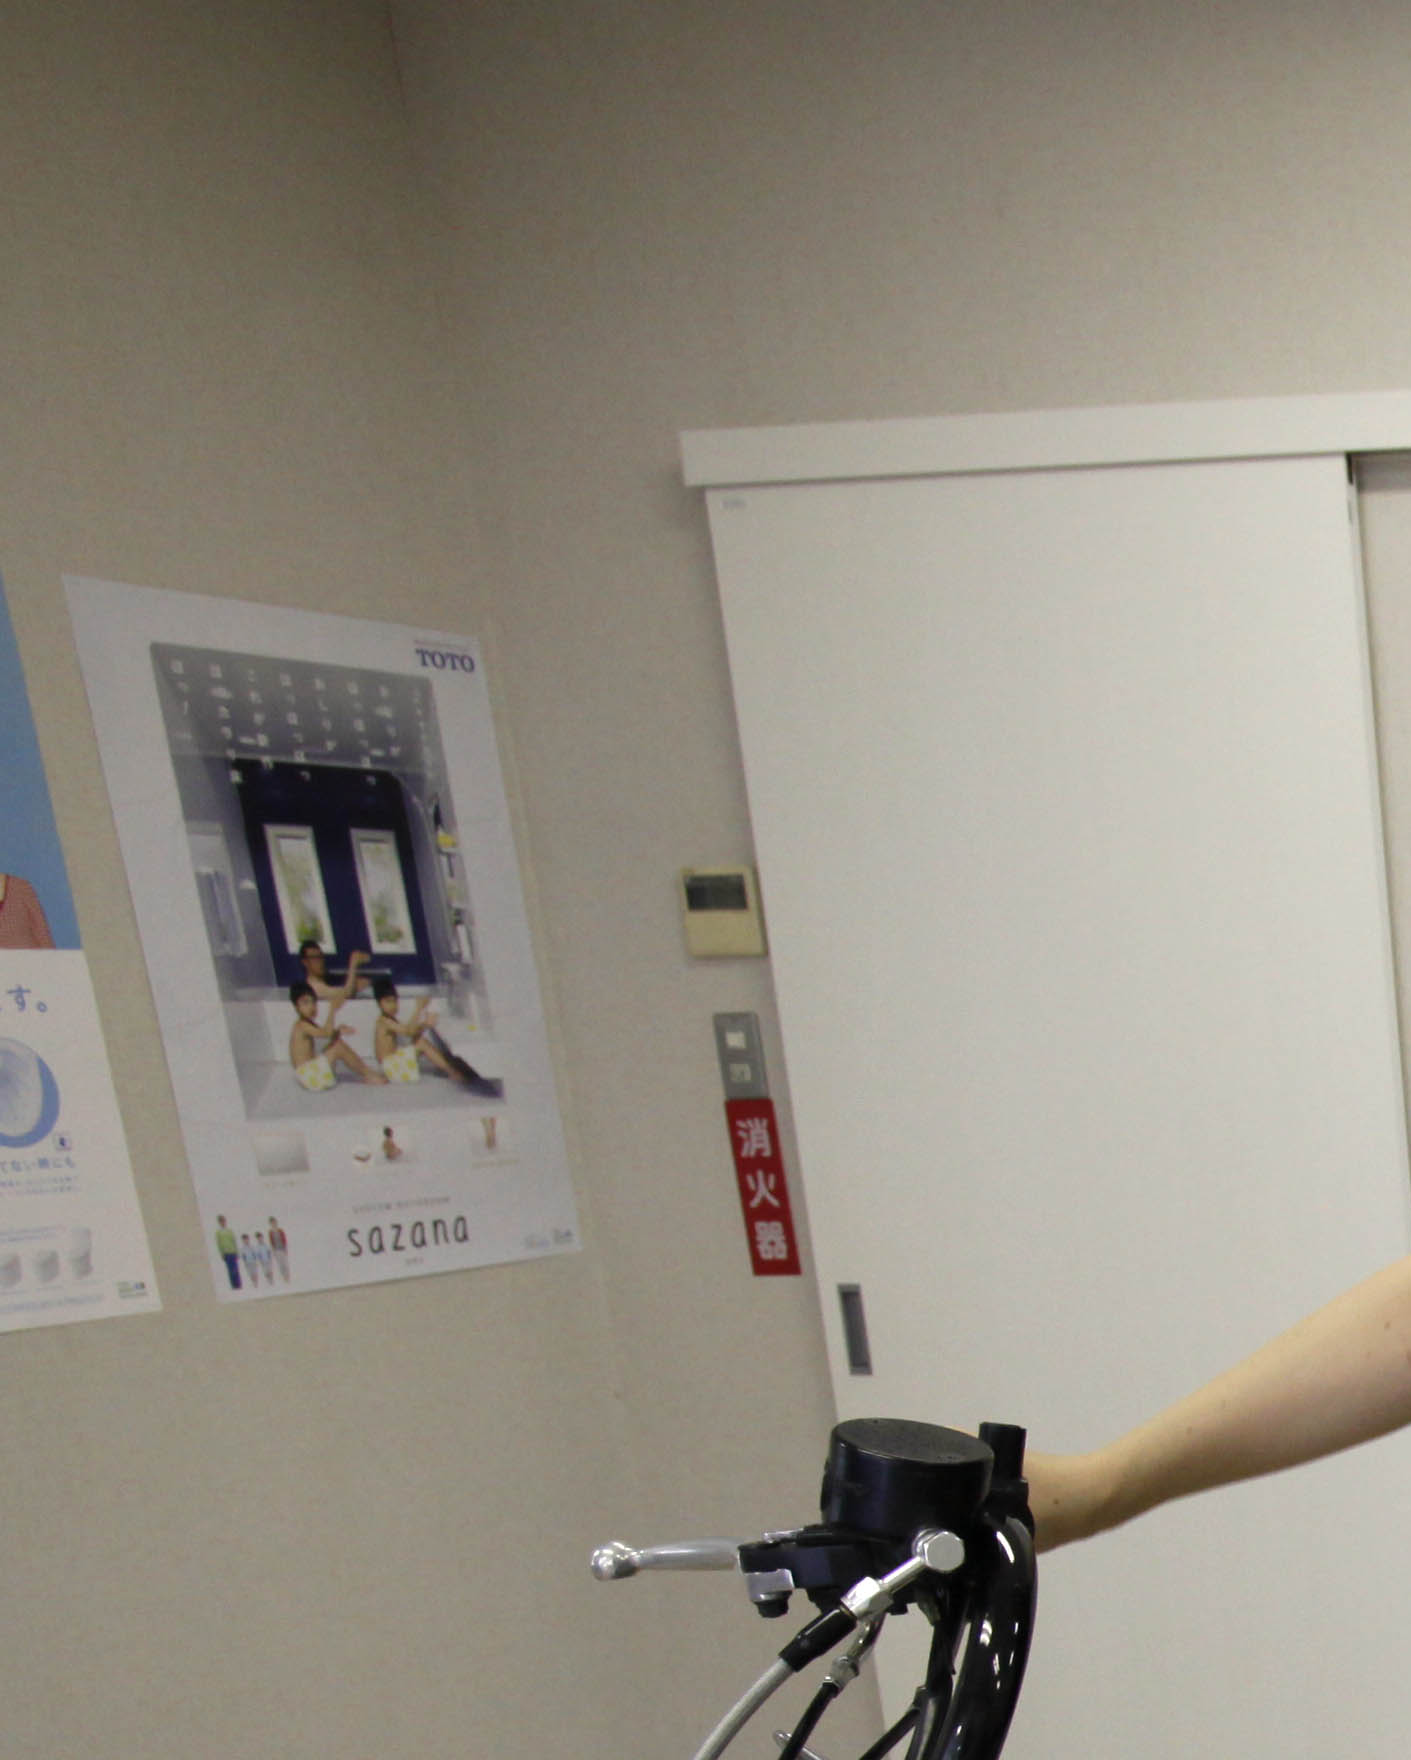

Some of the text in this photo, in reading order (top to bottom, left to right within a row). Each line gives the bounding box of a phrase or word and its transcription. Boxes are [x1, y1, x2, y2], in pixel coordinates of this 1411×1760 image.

[415, 648, 476, 672] TOTO
[735, 1117, 788, 1261] 消火器
[347, 1215, 470, 1258] sazana
